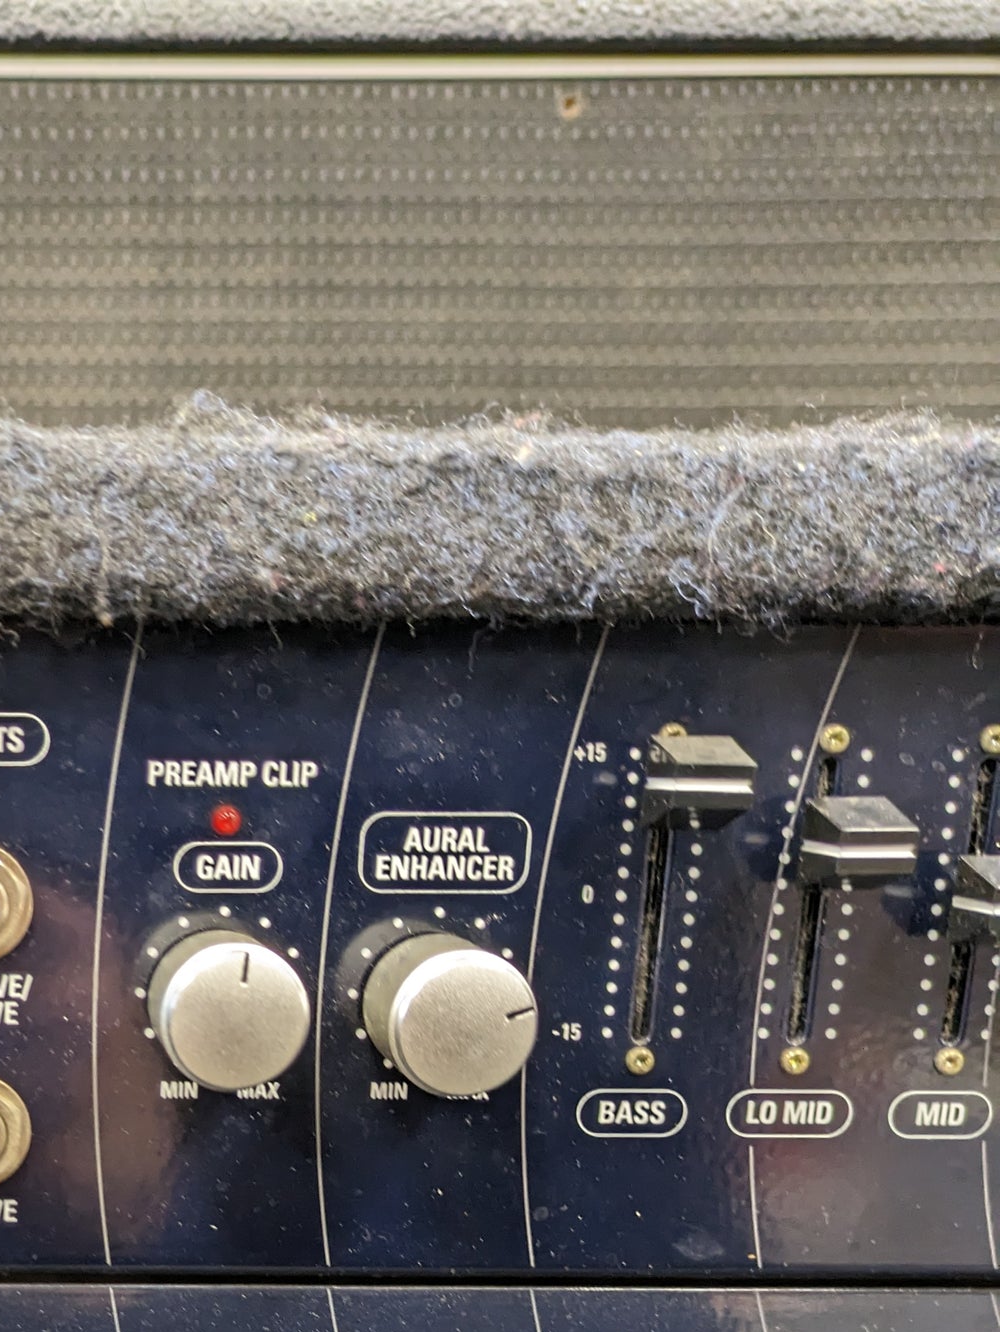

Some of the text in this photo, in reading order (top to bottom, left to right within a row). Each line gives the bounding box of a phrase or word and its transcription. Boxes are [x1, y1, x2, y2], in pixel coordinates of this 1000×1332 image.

[574, 741, 607, 763] +15
[148, 761, 318, 787] PREAMP CLIP
[404, 827, 489, 852] AURAL
[197, 855, 261, 880] GAIN
[375, 855, 514, 880] ENHANCER
[582, 885, 593, 903] 0
[552, 1023, 581, 1040] -15
[160, 1081, 198, 1099] MIN
[370, 1082, 407, 1099] MIN
[598, 1101, 666, 1124] BASS
[746, 1101, 833, 1124] LO MID
[916, 1102, 965, 1126] MID
